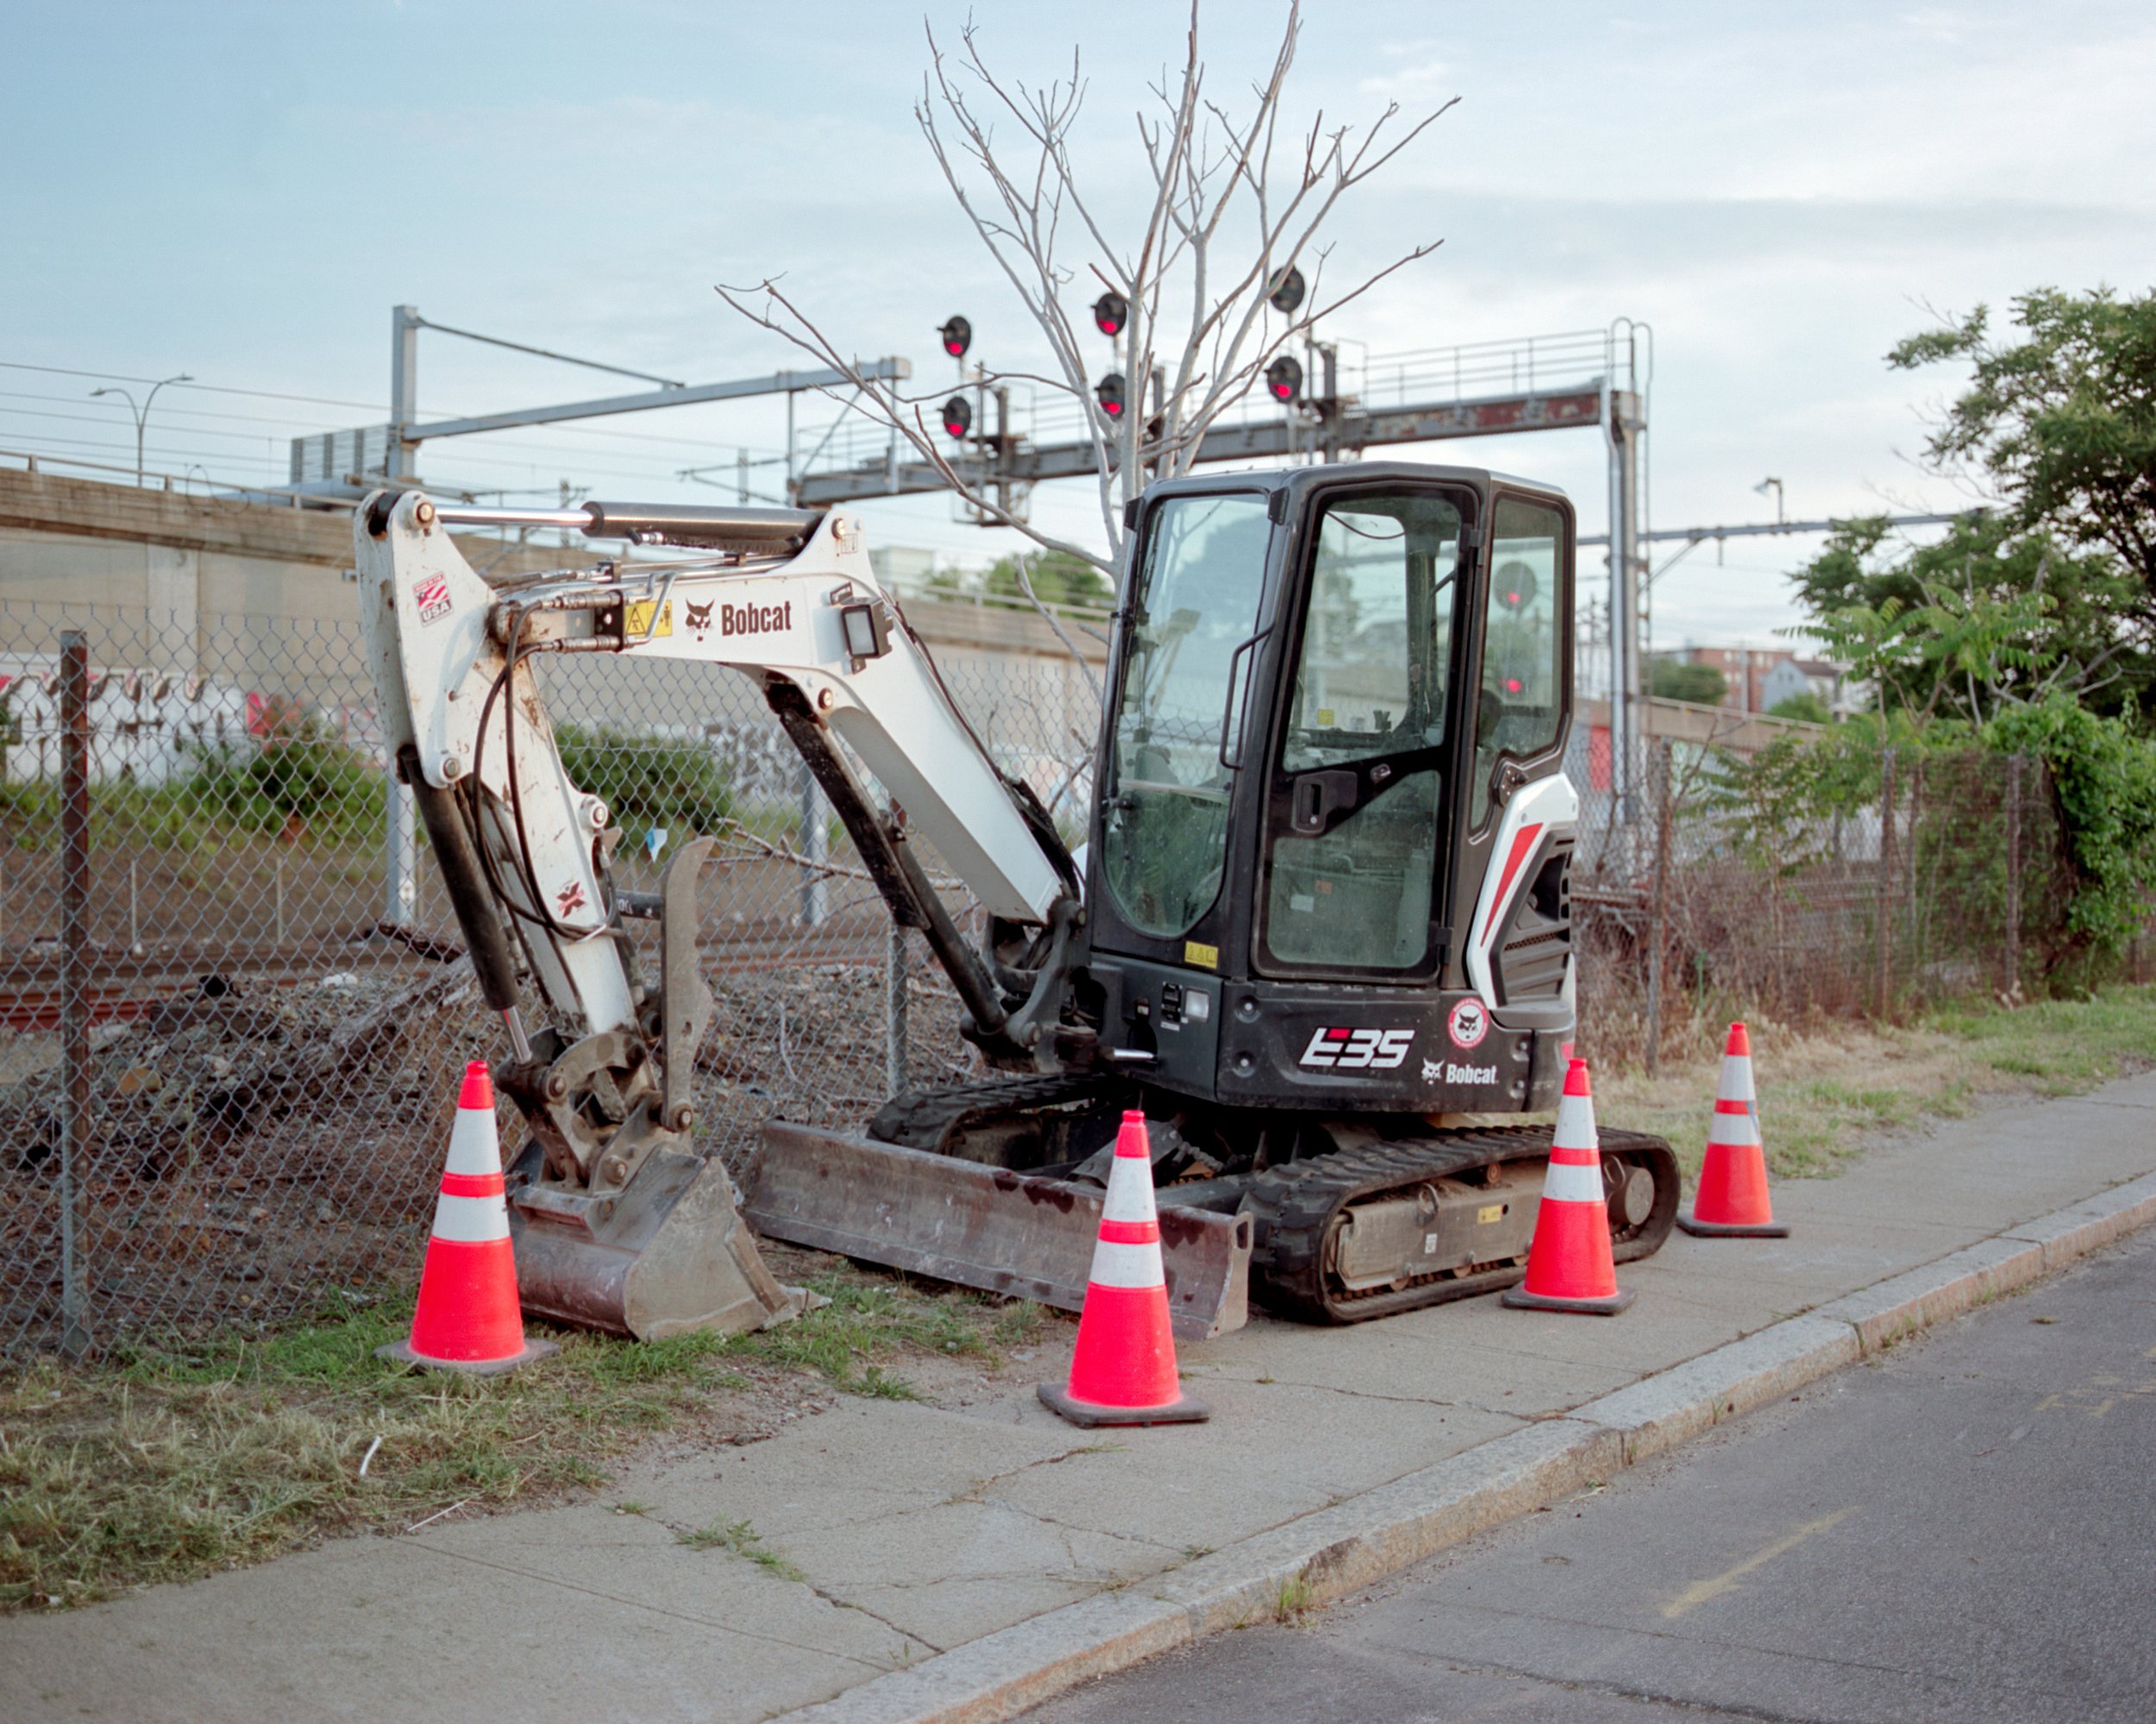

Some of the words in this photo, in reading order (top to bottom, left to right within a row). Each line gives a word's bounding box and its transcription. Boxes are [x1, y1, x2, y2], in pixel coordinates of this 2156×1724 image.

[422, 600, 450, 622] USA
[721, 600, 792, 636] Bobcat
[1299, 1027, 1415, 1068] E35
[1445, 1063, 1497, 1085] Bobcat
